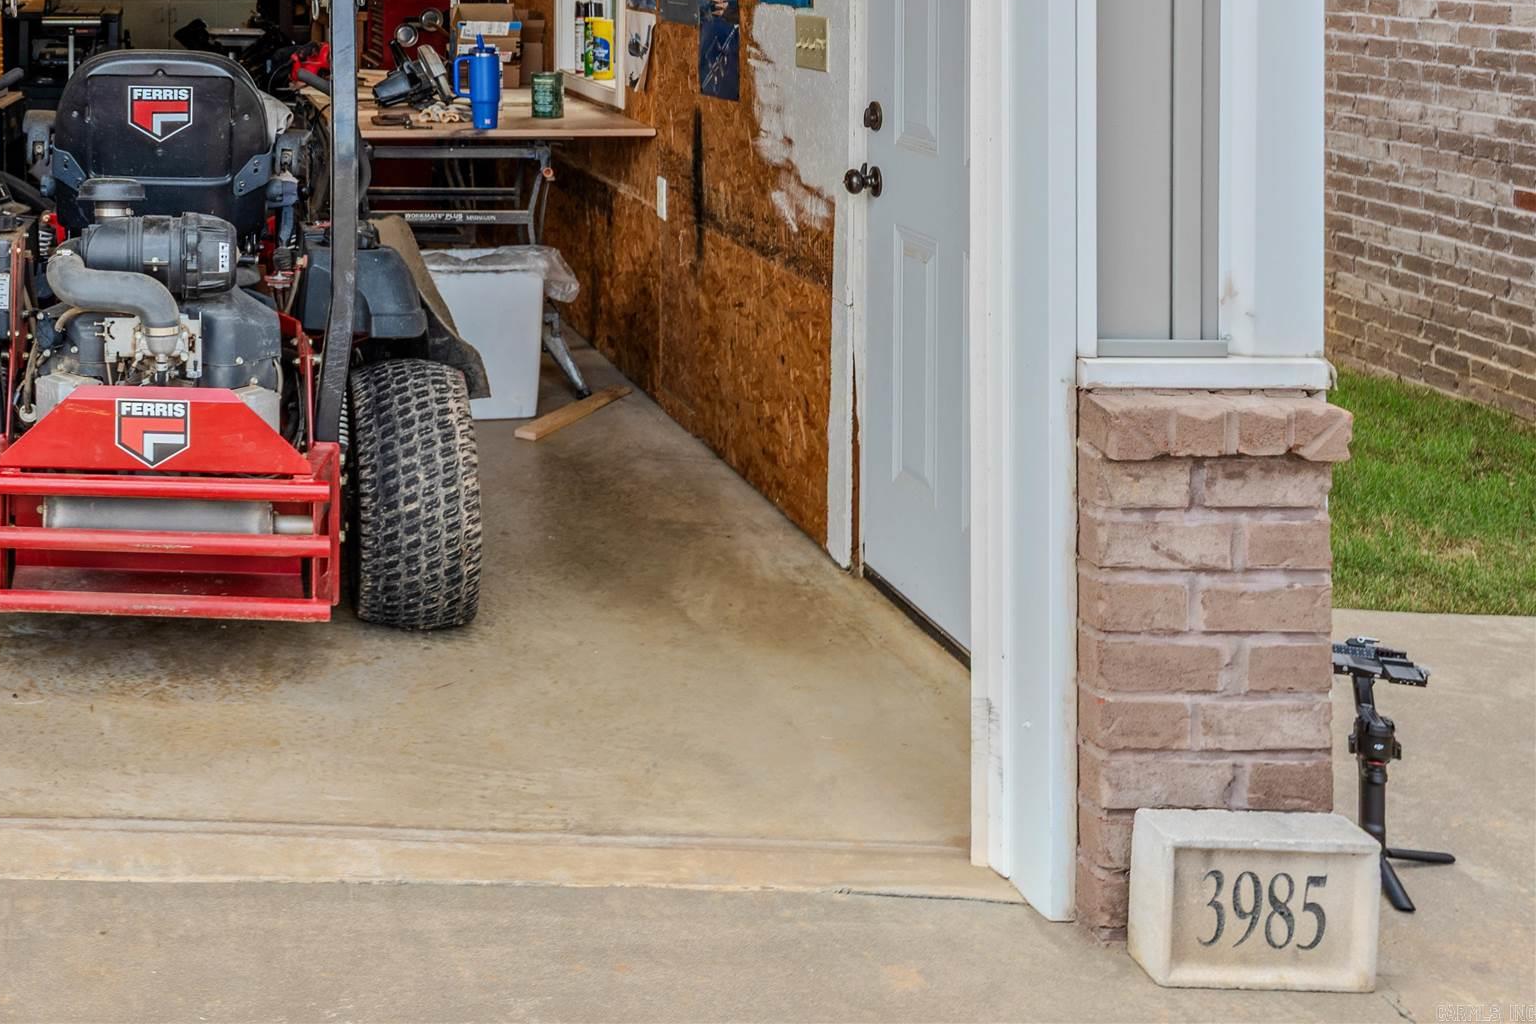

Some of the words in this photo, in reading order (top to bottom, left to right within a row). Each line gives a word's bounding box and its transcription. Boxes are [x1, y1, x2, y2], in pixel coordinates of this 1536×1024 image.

[132, 88, 190, 101] FERRIS
[120, 402, 186, 418] FERRIS
[1196, 869, 1328, 951] 3985
